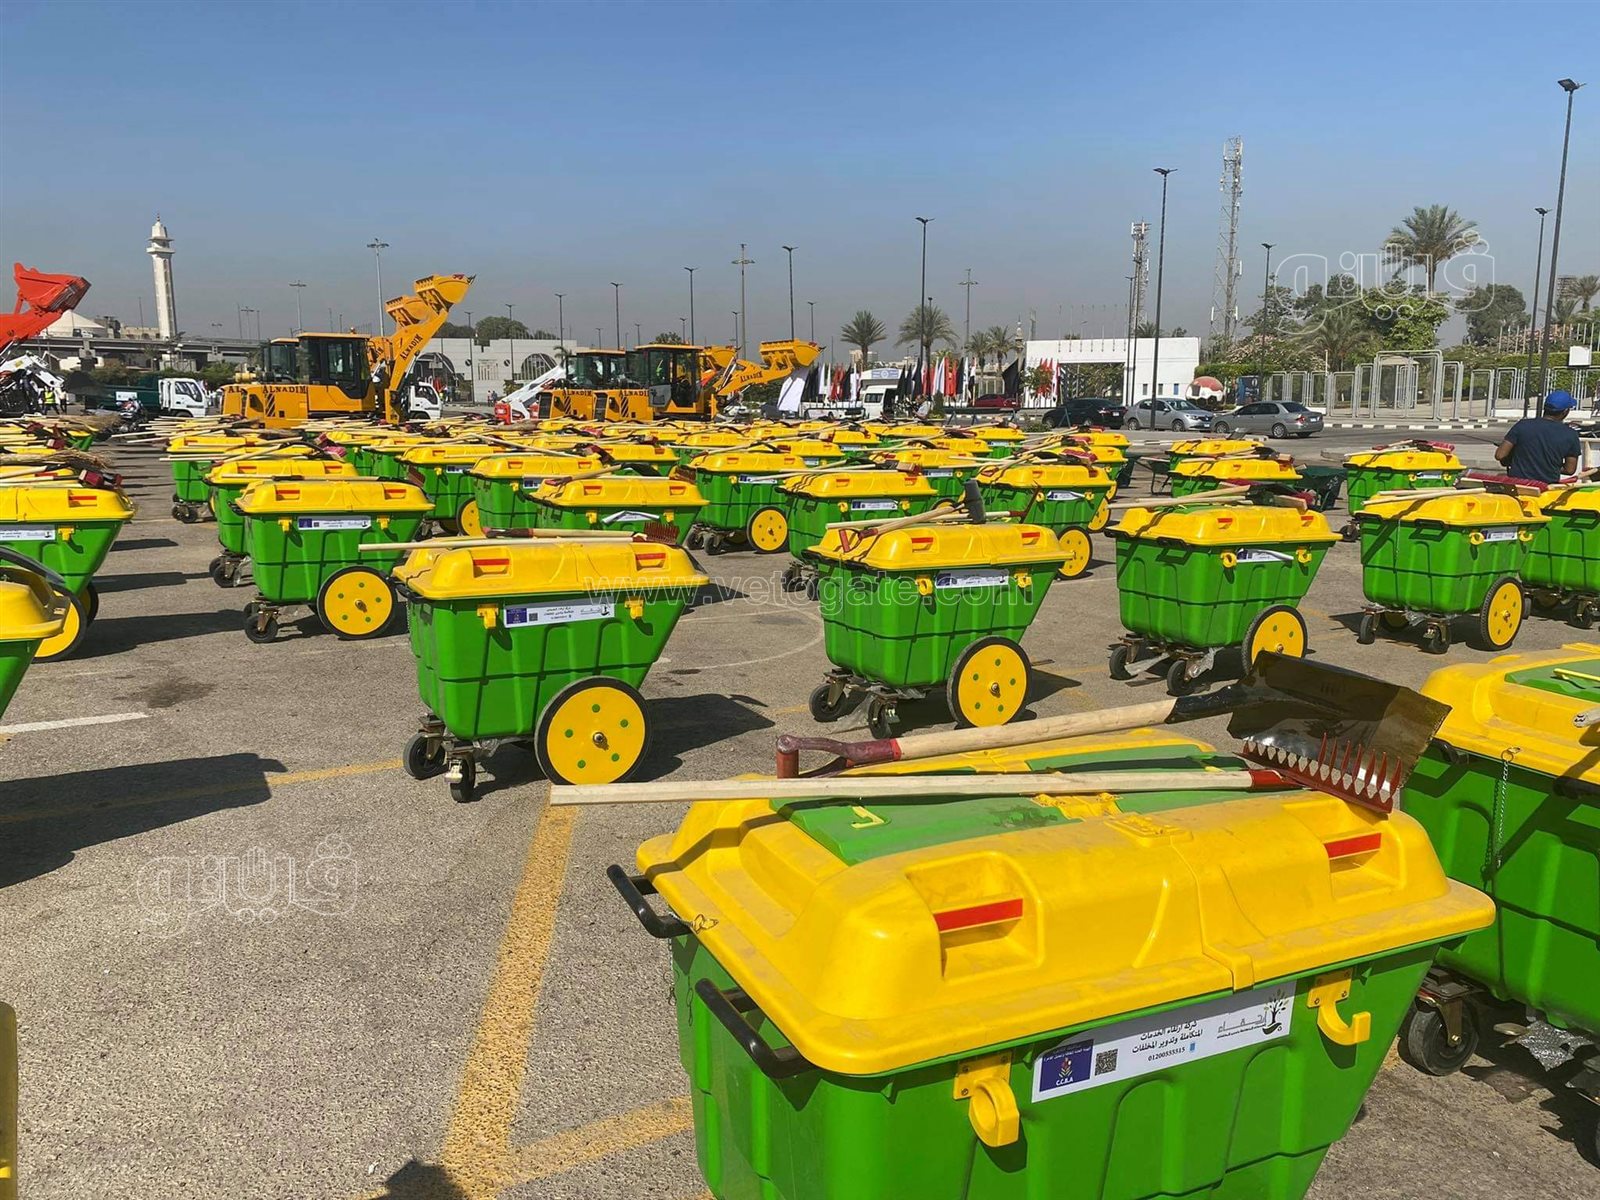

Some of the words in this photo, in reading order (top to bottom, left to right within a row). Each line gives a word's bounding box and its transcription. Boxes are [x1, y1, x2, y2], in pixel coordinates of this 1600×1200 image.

[262, 385, 306, 394] ALNADIM
[619, 389, 649, 397] ALNADI
[1140, 1028, 1166, 1041] الخدمات
[1180, 1029, 1203, 1041] المتكاملة
[1132, 1041, 1158, 1053] المخلفات
[1158, 1037, 1178, 1048] وتدوير
